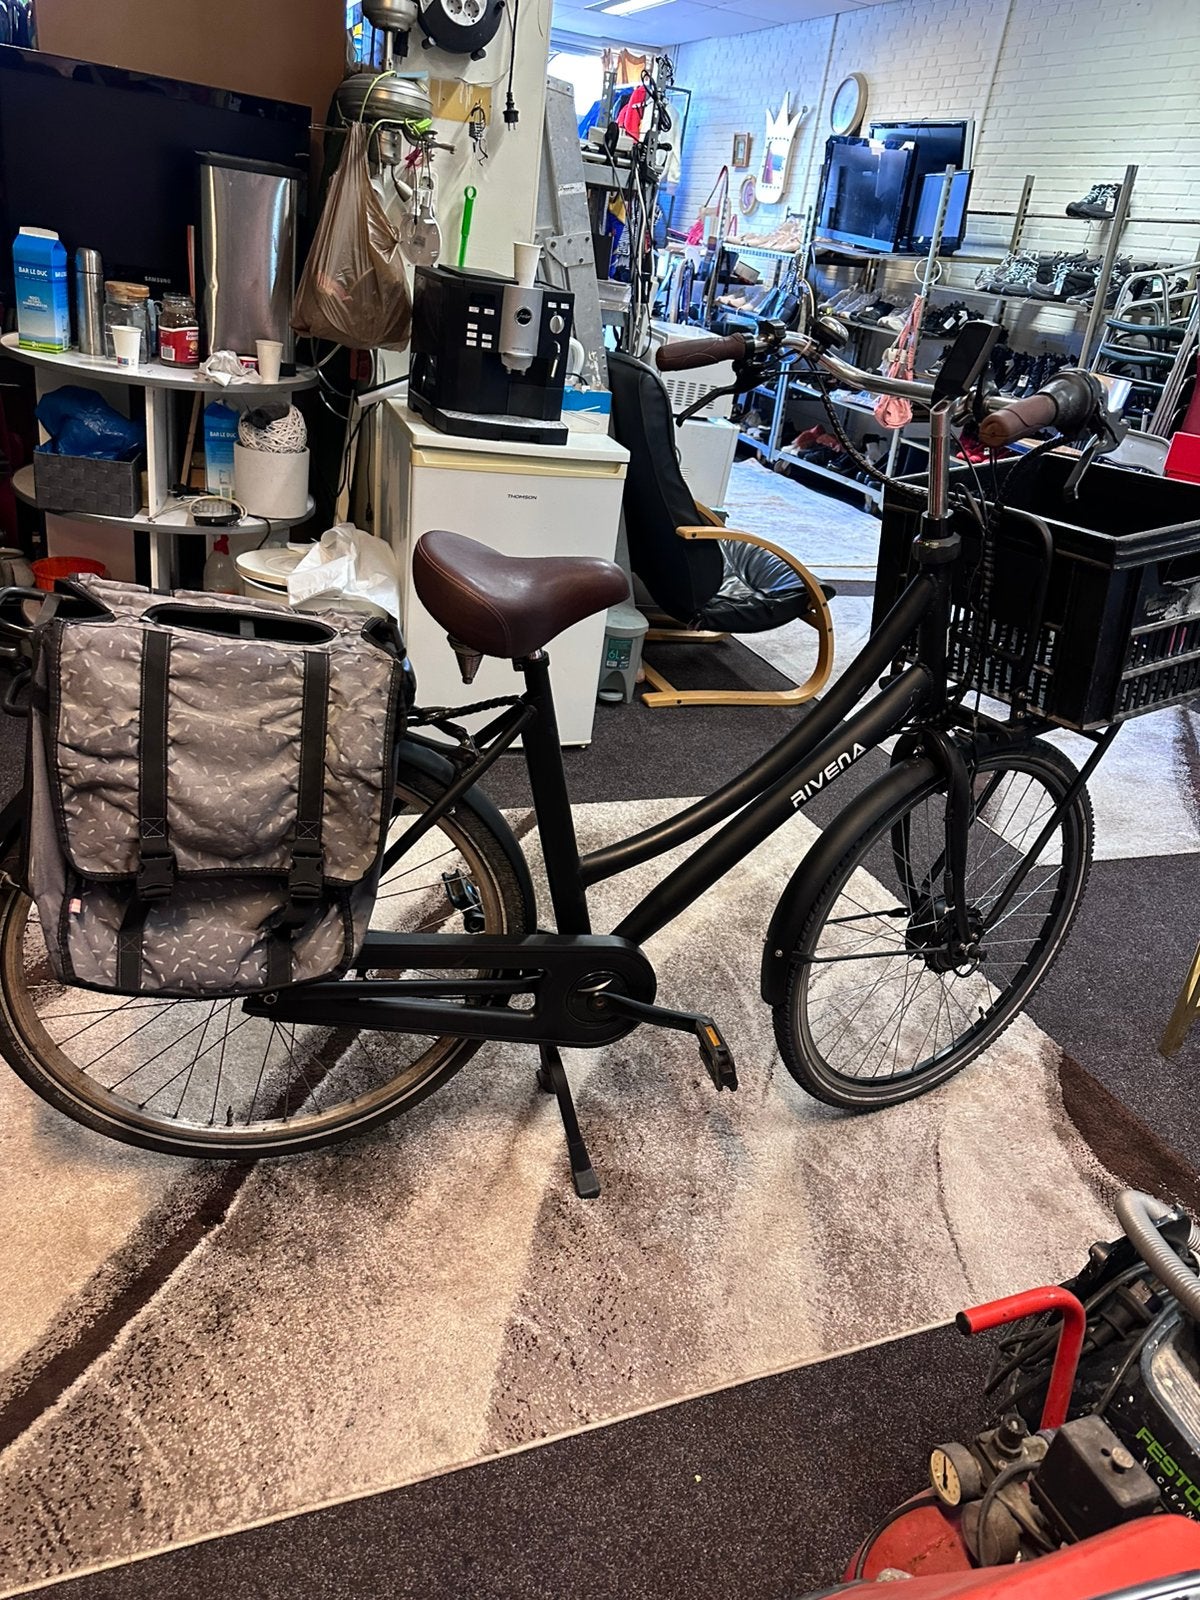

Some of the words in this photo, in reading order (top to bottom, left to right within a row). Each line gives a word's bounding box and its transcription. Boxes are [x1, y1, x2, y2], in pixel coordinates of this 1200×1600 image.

[144, 276, 171, 284] SAMSUNG
[790, 742, 867, 808] RIVENA
[1135, 1426, 1200, 1513] FESTO
[1156, 1475, 1200, 1522] CLEAN
